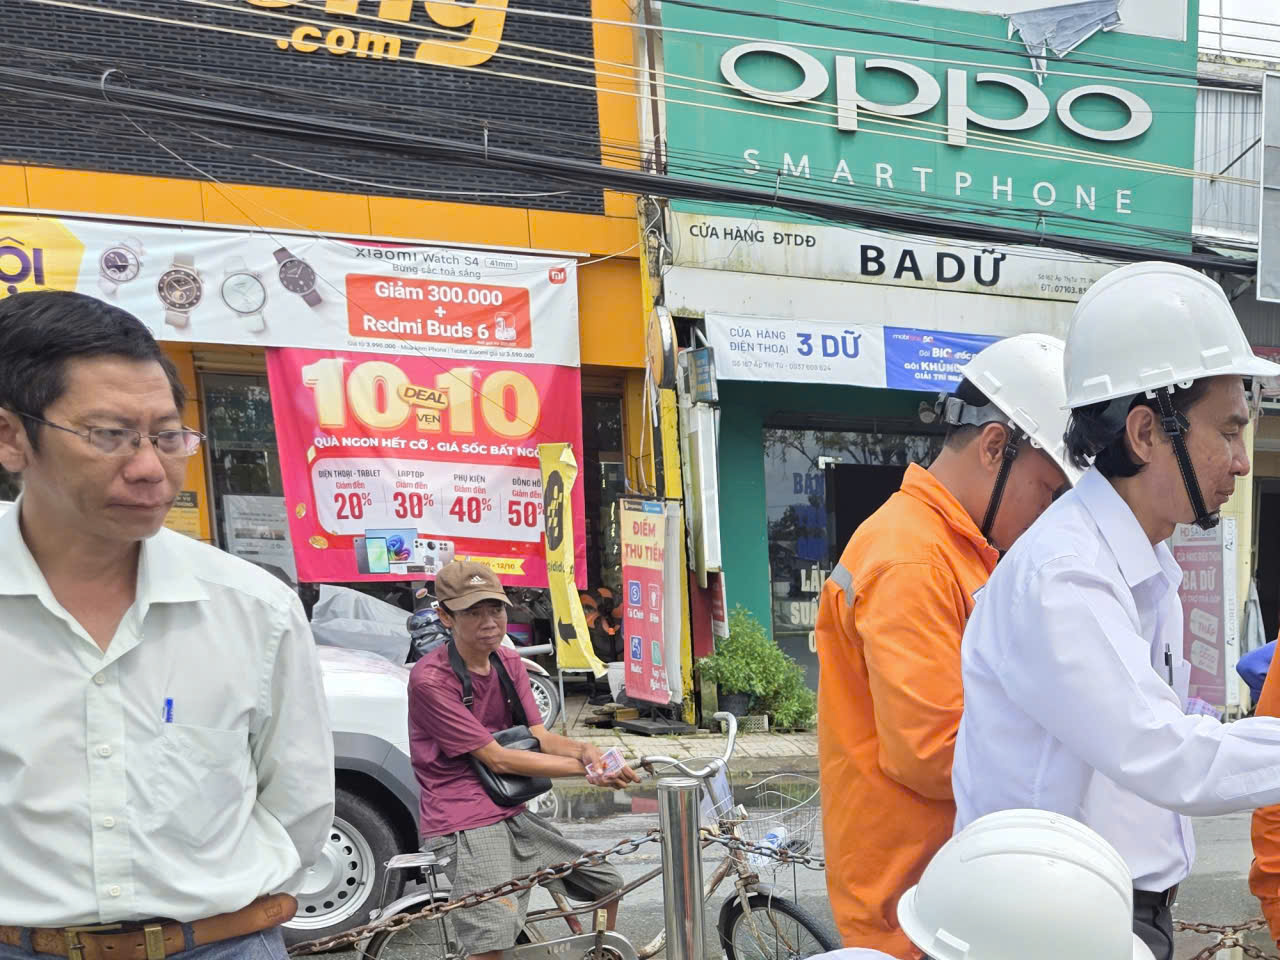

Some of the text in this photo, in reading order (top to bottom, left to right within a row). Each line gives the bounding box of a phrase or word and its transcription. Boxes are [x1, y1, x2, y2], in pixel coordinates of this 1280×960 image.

[276, 25, 402, 61] .com
[743, 148, 1133, 215] SMARTPHONE
[689, 222, 817, 248] CỬA HÀNG ĐTDĐ
[423, 252, 460, 267] Watch
[464, 255, 480, 267] S4
[489, 259, 513, 269] 41mm
[374, 281, 503, 306] Giảm 300.000
[362, 314, 489, 340] Redmi Buds 6
[728, 326, 786, 341] CỬA HÀNG
[729, 341, 789, 356] ĐIỆN THOẠI
[796, 329, 863, 359] 3 DỮ
[403, 386, 446, 405] DEAL
[314, 435, 339, 450] QUÀ
[341, 436, 379, 449] NGON
[381, 435, 407, 451] HẾT
[409, 437, 429, 451] CỠ
[437, 439, 460, 453] GIÁ
[461, 440, 489, 456] SỐC
[490, 441, 515, 457] BẤT
[357, 469, 381, 479] TABLET
[397, 469, 425, 479] LAPTOP
[333, 492, 373, 520] 20%
[392, 491, 435, 519] 30%
[449, 496, 492, 524] 40%
[632, 515, 656, 538] ĐIỂM
[624, 543, 643, 560] THU
